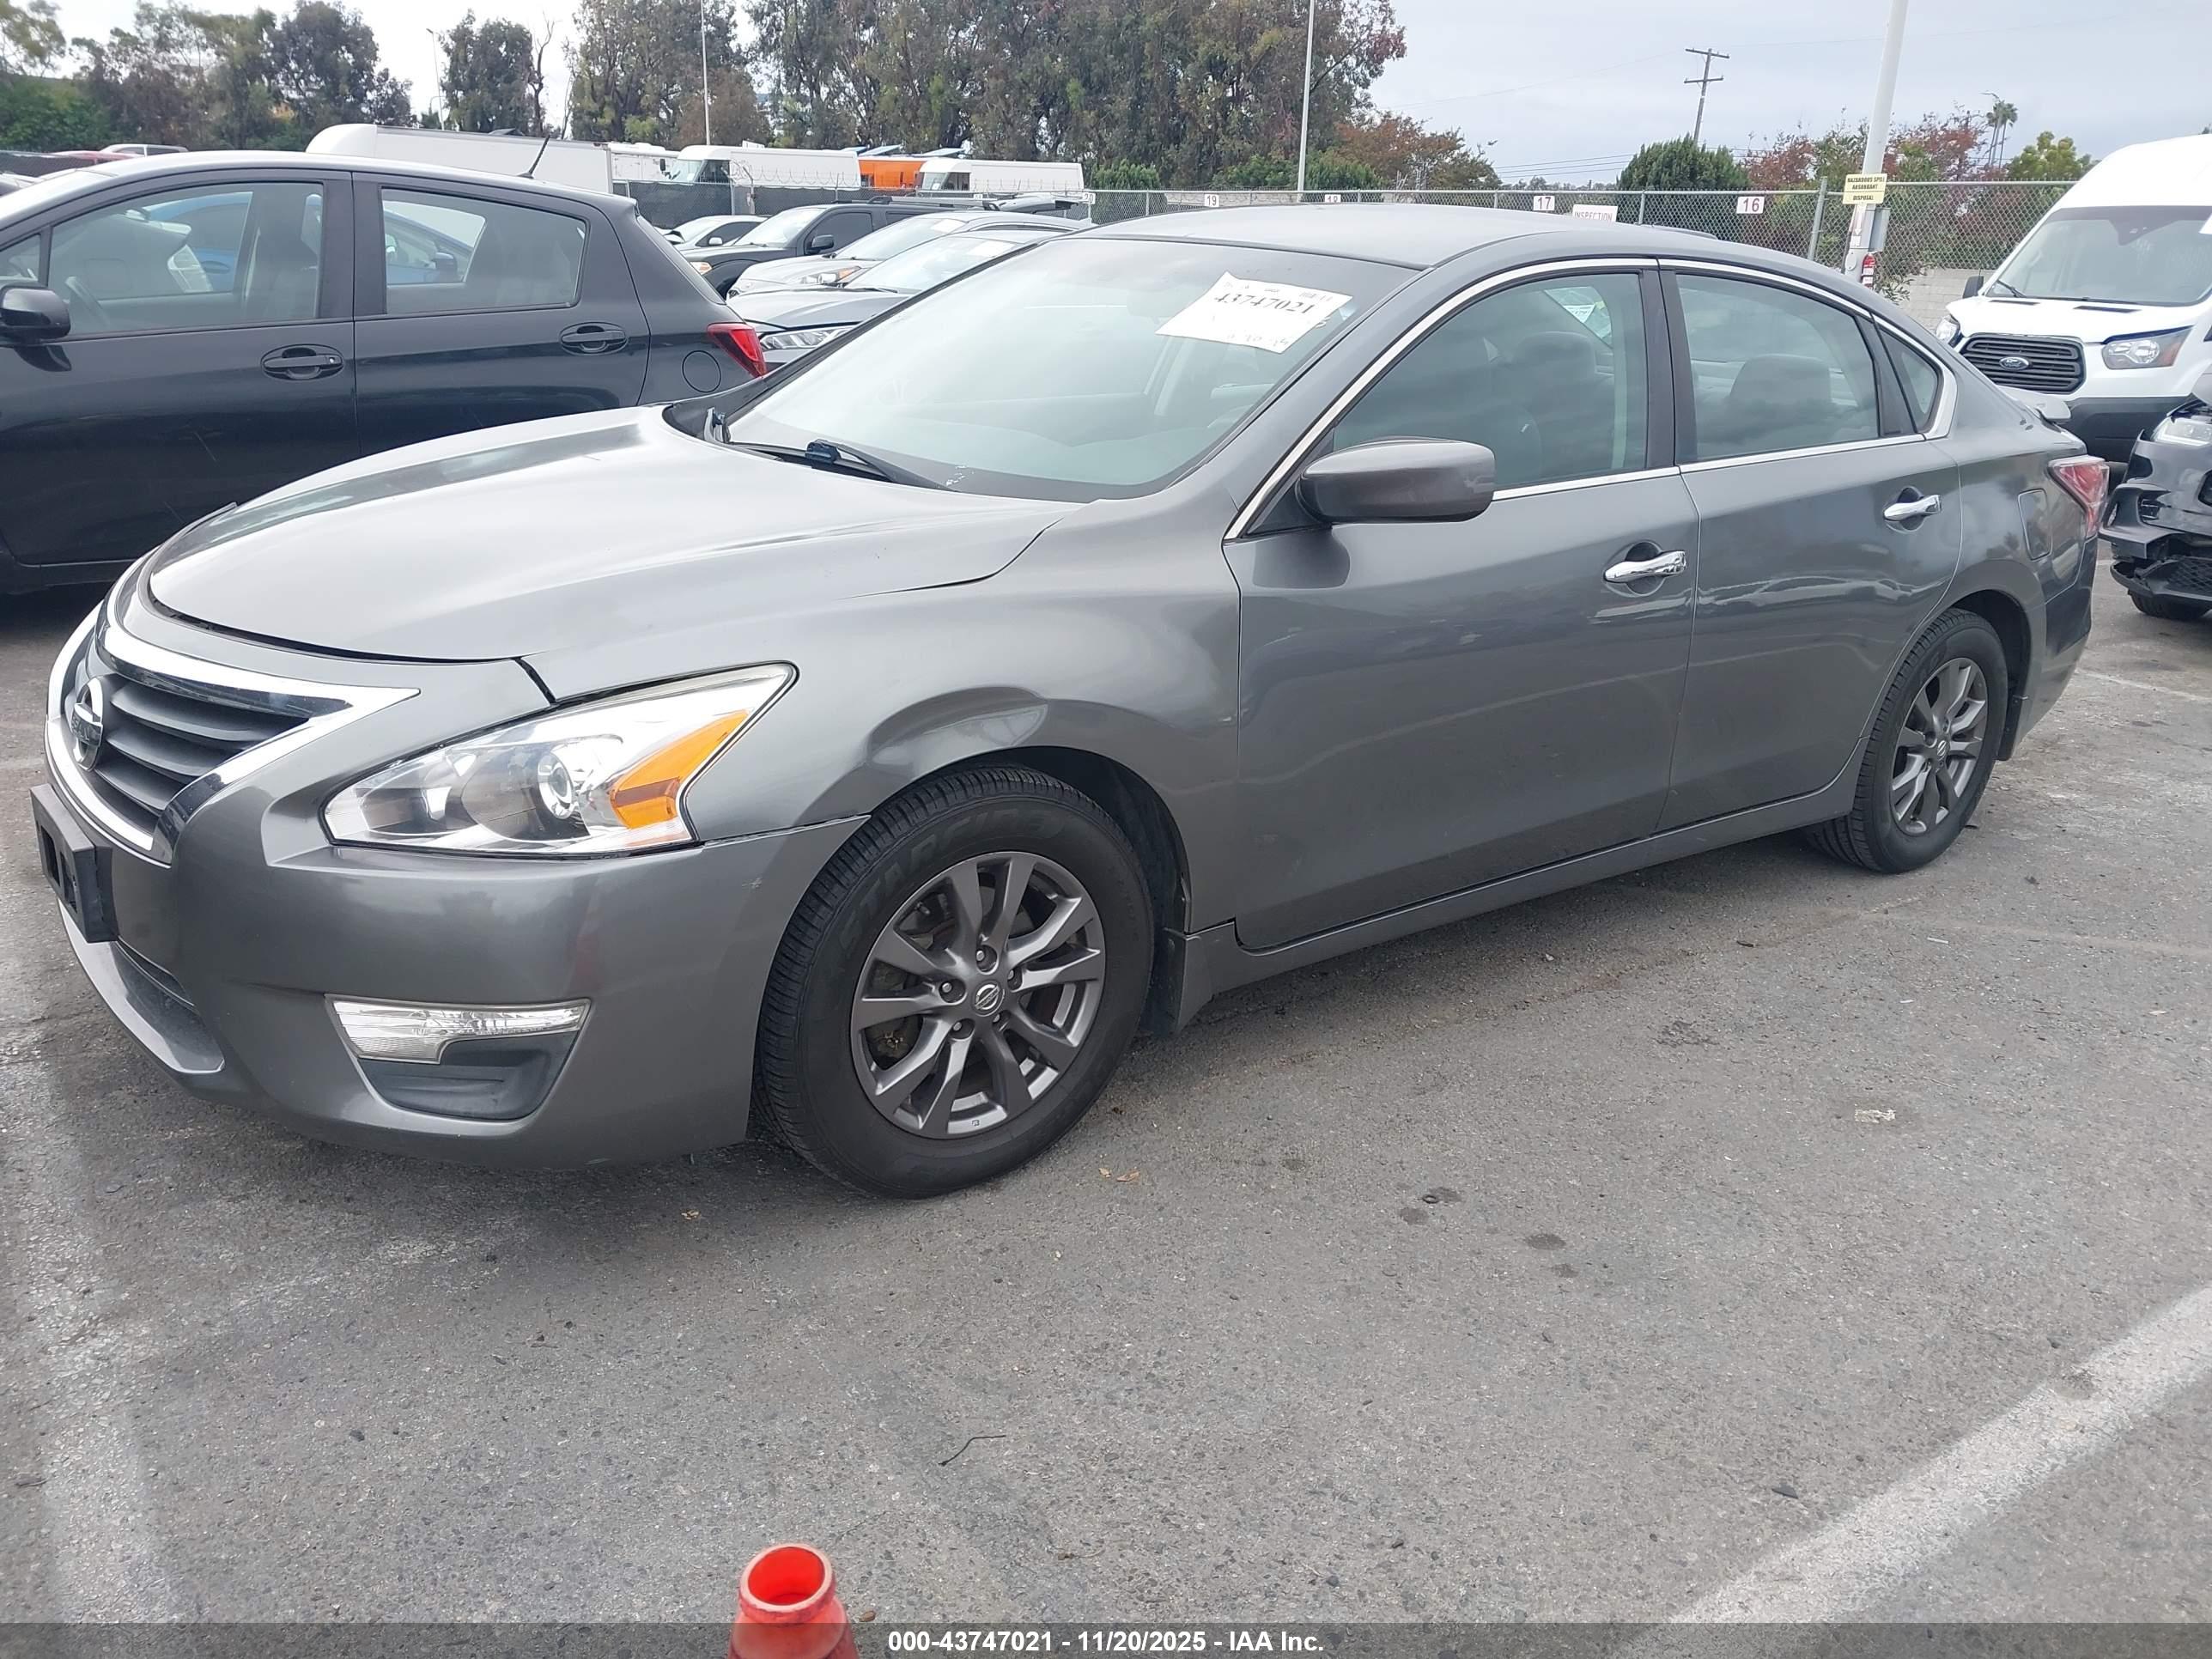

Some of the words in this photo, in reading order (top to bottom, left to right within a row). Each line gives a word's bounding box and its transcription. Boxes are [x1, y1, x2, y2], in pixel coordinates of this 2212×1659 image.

[1206, 195, 1217, 206] 19
[1537, 197, 1552, 210] 17
[1743, 198, 1760, 212] 16
[1574, 211, 1613, 221] INSPECTION
[1214, 293, 1316, 313] 43747021
